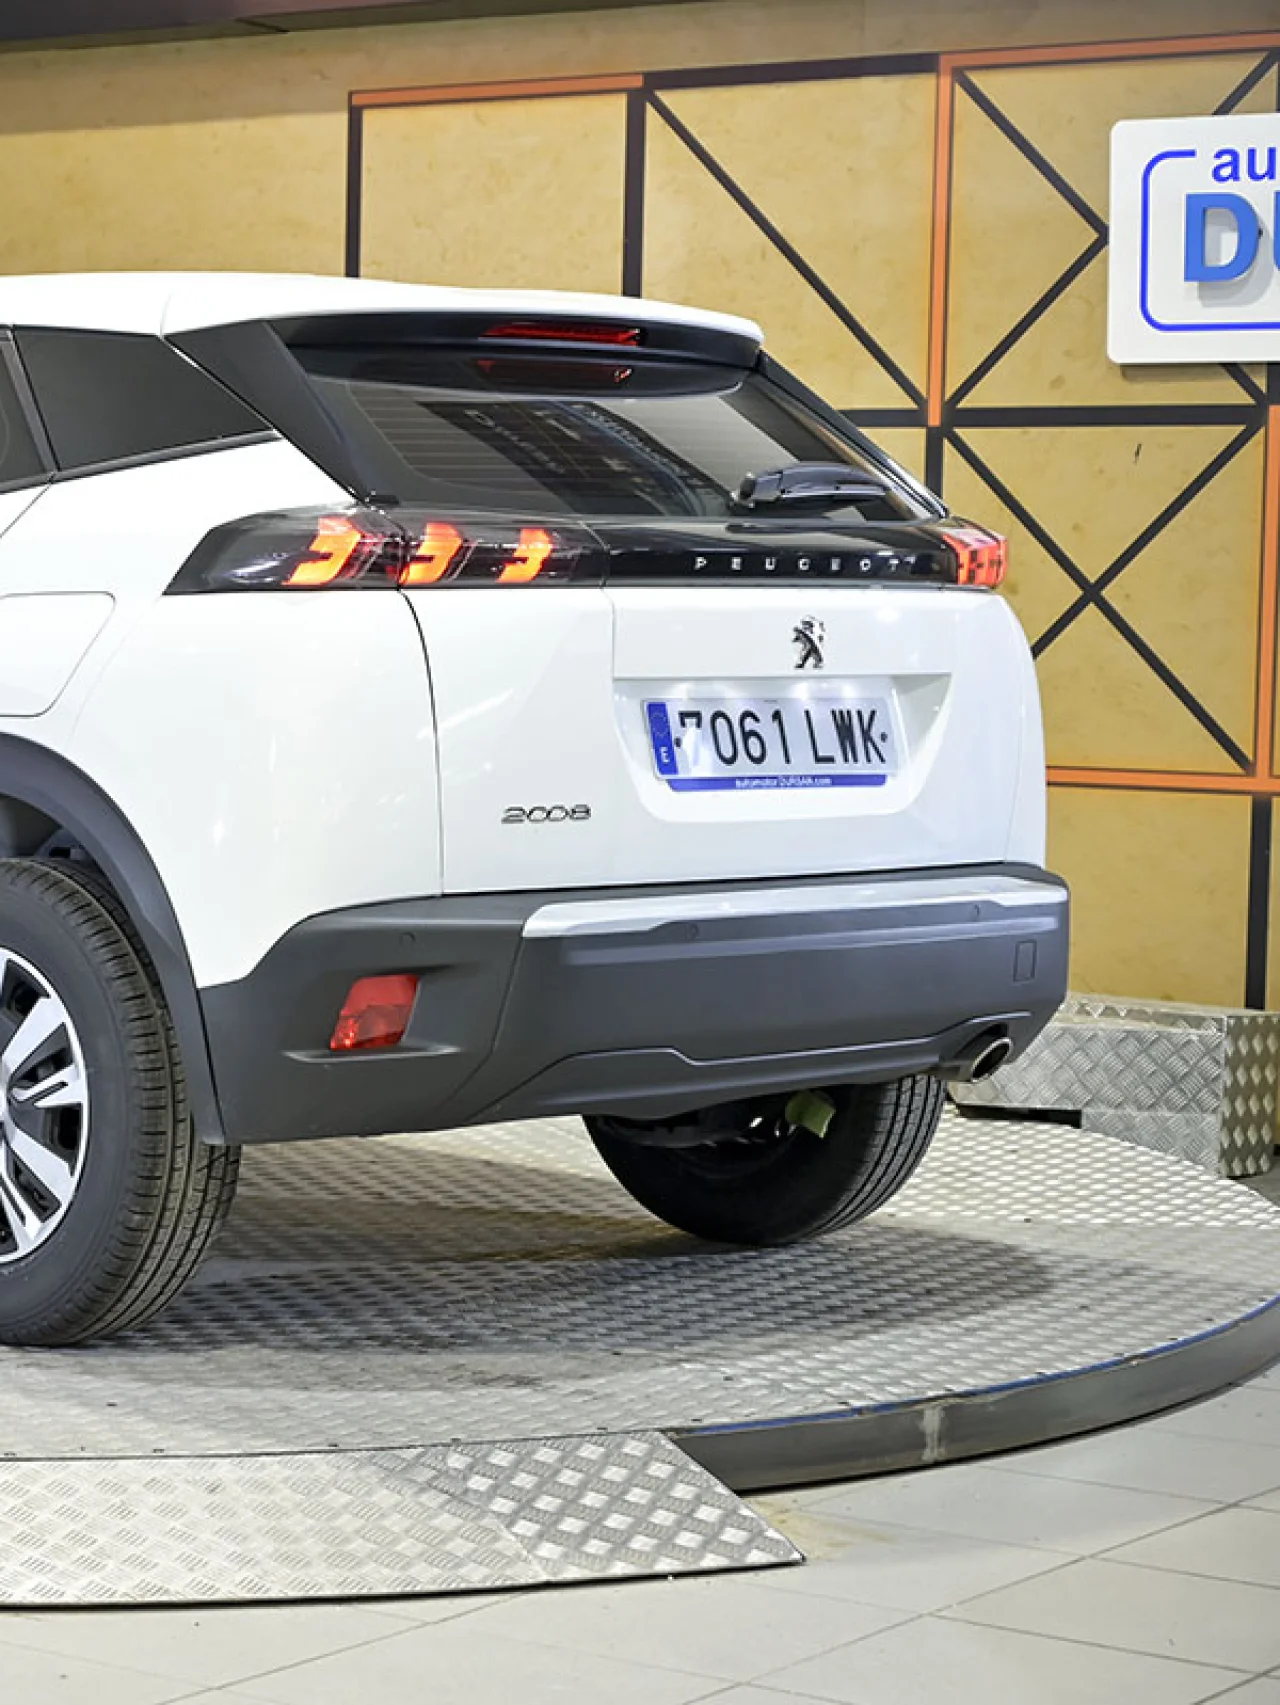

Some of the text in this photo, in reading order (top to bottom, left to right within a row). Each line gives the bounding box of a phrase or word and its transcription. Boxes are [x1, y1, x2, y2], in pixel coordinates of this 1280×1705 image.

[1183, 190, 1280, 282] D
[694, 556, 899, 572] PEUGEOT
[678, 709, 886, 766] 7061 LWK
[660, 746, 671, 764] E
[501, 804, 591, 824] 2008
